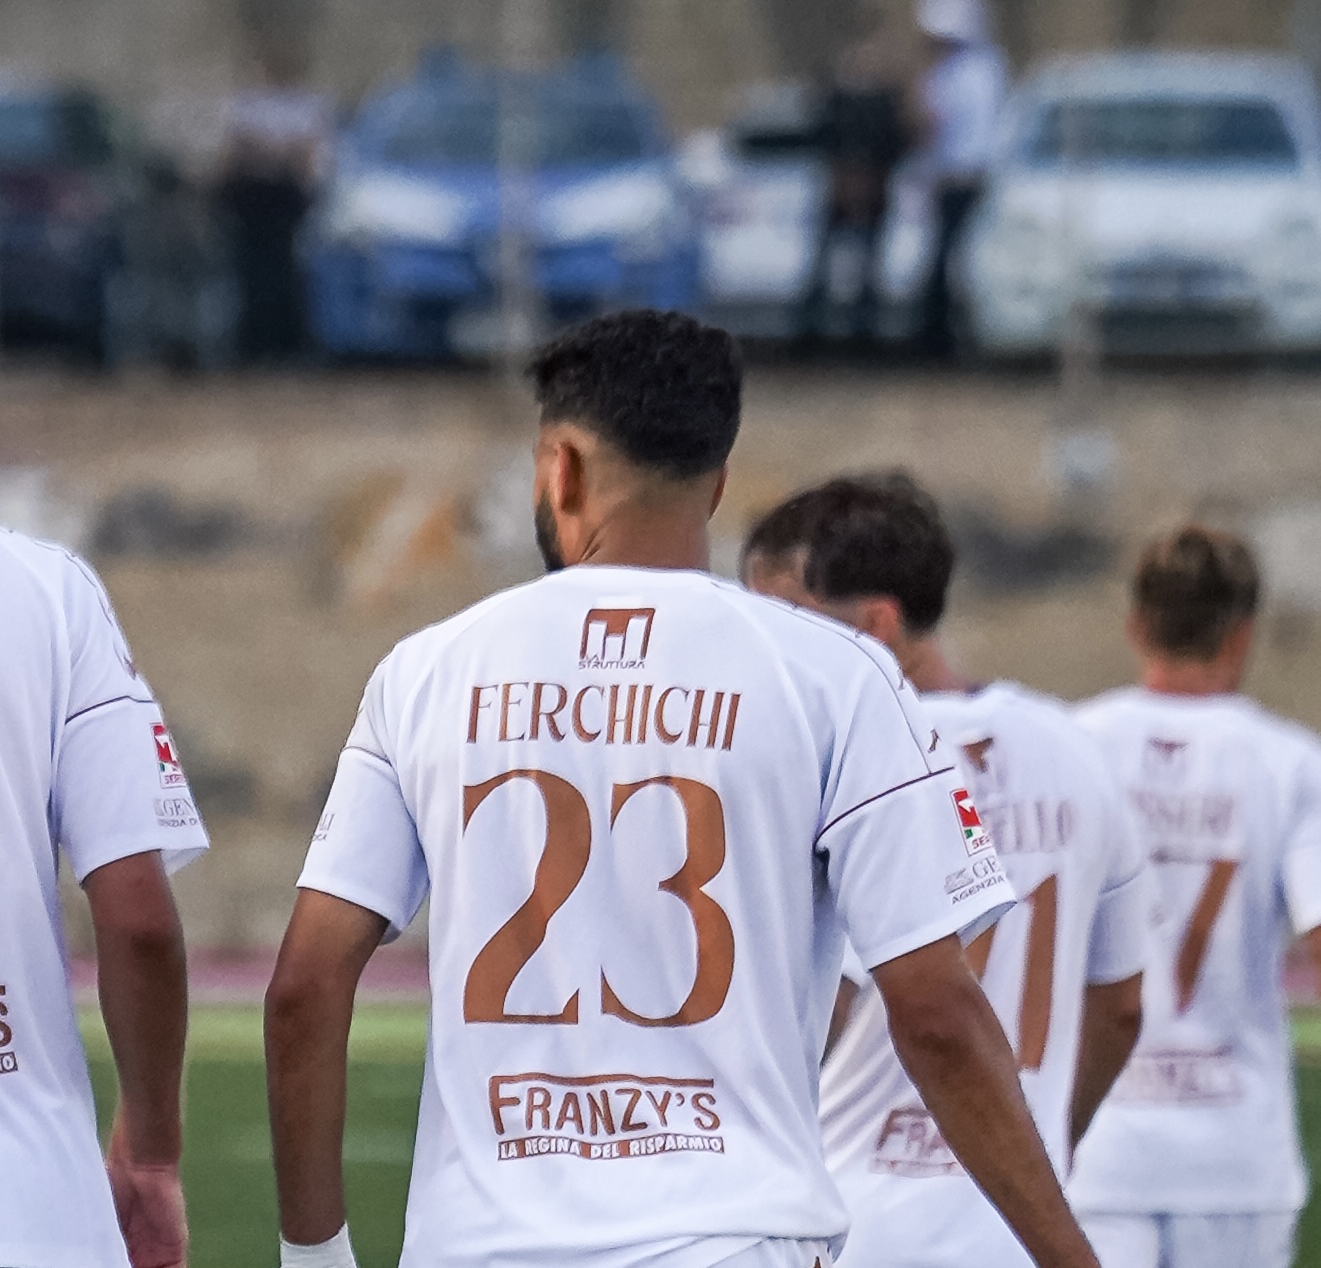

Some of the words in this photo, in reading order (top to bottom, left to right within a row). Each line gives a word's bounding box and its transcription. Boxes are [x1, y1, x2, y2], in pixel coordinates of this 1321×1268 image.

[466, 682, 742, 751] FERCHICHI
[463, 769, 735, 1027] 23
[489, 1072, 720, 1135] FRANZY'S
[500, 1143, 517, 1160] LA
[524, 1138, 581, 1156] REGINA
[590, 1145, 620, 1159] DEL
[629, 1135, 722, 1156] RISPARMIO
